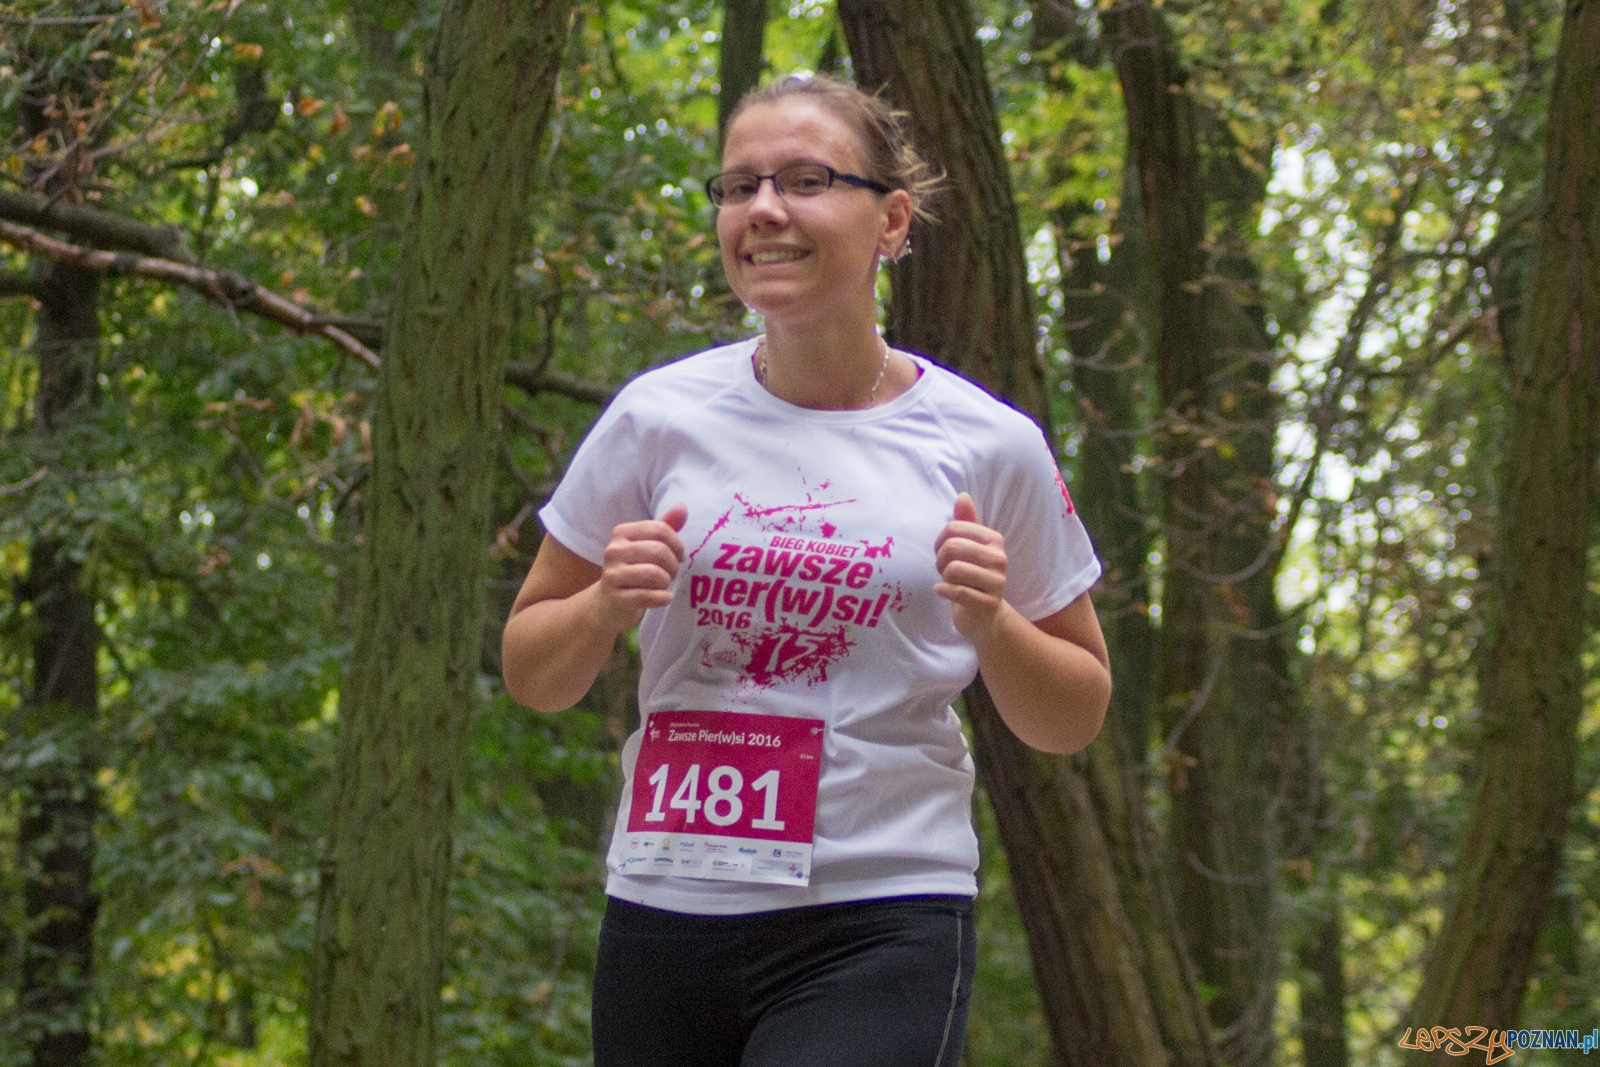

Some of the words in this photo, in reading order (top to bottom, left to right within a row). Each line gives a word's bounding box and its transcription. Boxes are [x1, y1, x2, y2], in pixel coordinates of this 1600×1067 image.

[769, 535, 805, 550] BIEG
[805, 539, 860, 558] KOBIET
[712, 543, 873, 589] zawsze
[697, 607, 752, 630] 2016
[668, 730, 697, 742] Zawsze
[698, 729, 745, 745] Pier(w)si
[747, 733, 781, 748] 2016
[644, 763, 785, 831] 1481
